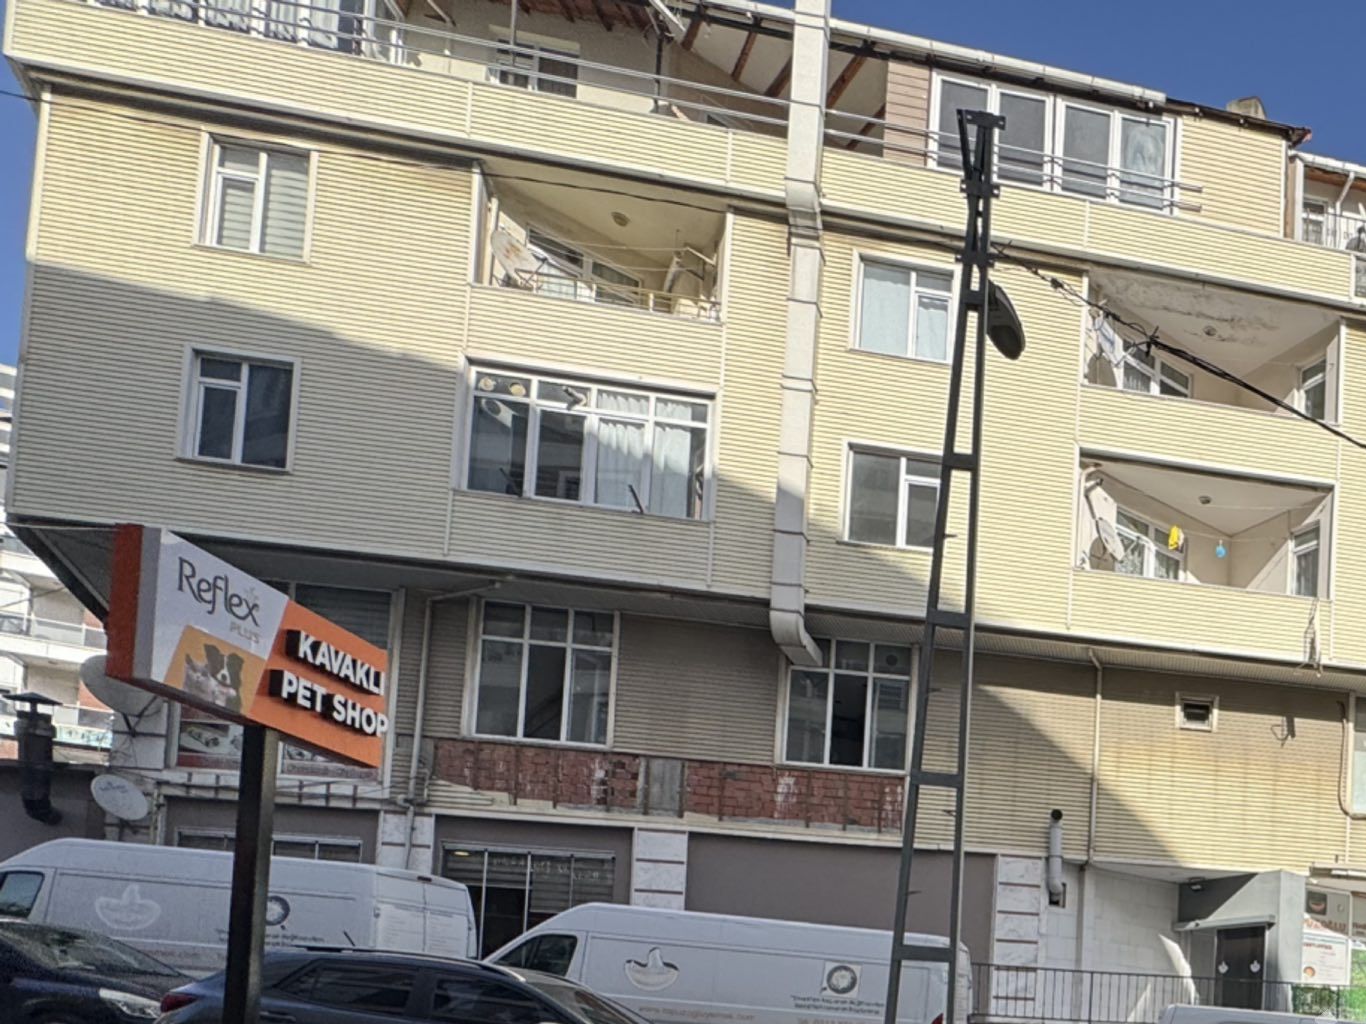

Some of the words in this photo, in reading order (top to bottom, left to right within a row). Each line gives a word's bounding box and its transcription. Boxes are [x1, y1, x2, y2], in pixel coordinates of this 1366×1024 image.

[177, 556, 261, 628] Reflex
[297, 630, 386, 697] KAVAKLI
[281, 669, 327, 714] PET
[332, 694, 389, 738] SHOP
